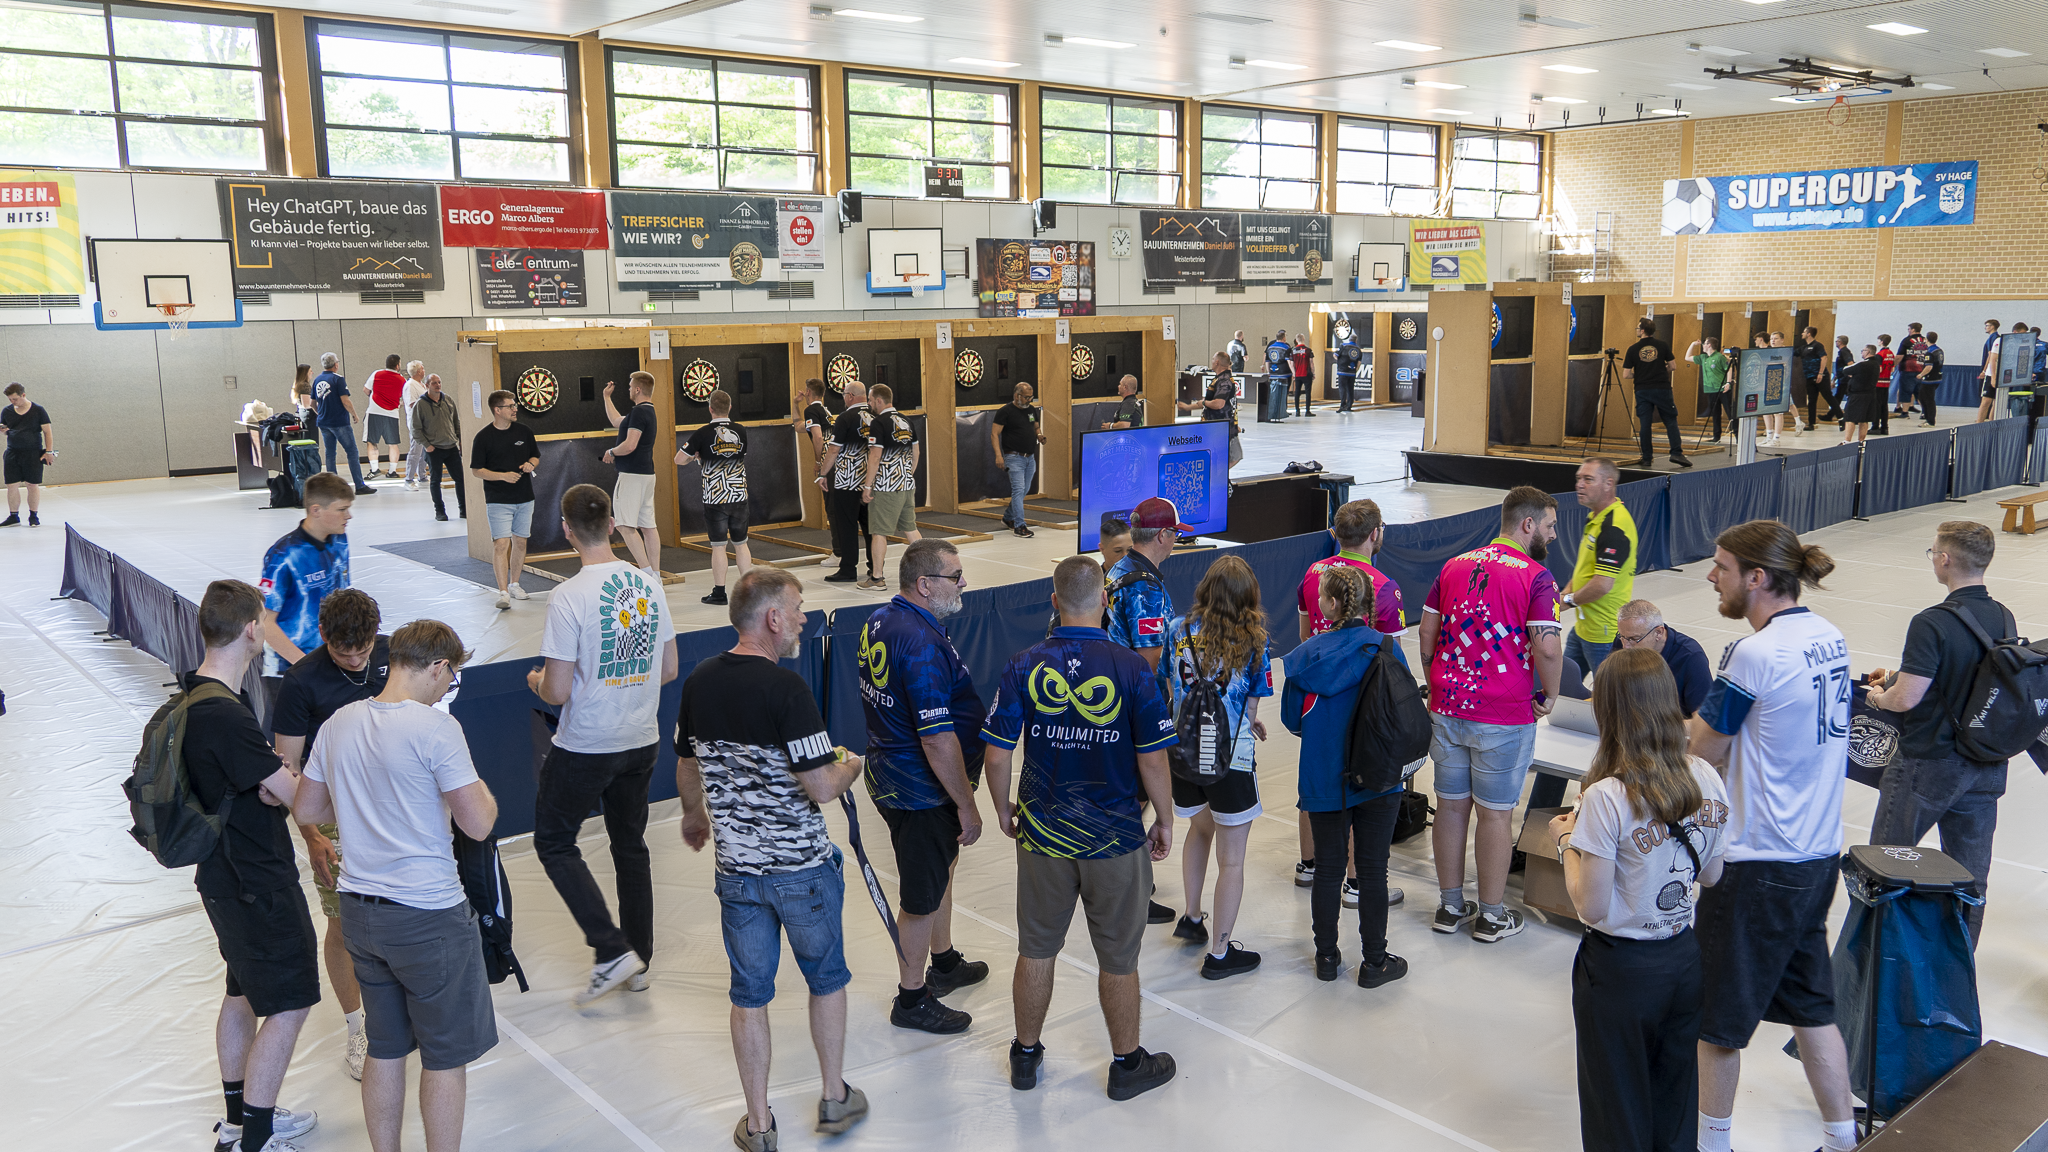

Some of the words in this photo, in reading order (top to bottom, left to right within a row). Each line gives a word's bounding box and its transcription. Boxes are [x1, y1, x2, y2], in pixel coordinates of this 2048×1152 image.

[928, 178, 941, 186] HEIM
[1935, 173, 1947, 182] SV
[1948, 171, 1973, 181] HAGE
[1, 187, 55, 203] EBEN.
[1728, 170, 1899, 210] SUPERCUP
[247, 197, 280, 217] Hey
[283, 198, 357, 216] ChatGPT,
[360, 199, 399, 215] baue
[402, 200, 428, 215] das
[500, 203, 564, 214] Generalagentur
[740, 208, 751, 217] TB
[7, 211, 50, 223] HITS!
[448, 209, 494, 225] ERGO
[501, 214, 527, 222] Marco
[528, 214, 554, 223] Albers
[622, 215, 704, 228] TREFFSICHER
[796, 218, 807, 226] Wir
[249, 218, 324, 234] Gebäude
[327, 219, 375, 237] fertig.
[501, 225, 553, 233] marco-albers.ergo.de
[792, 226, 812, 235] stellen
[622, 232, 649, 244] WIE
[651, 233, 682, 244] WIR?
[1415, 231, 1427, 240] WIR
[1428, 230, 1448, 239] LIEBEN
[1449, 229, 1459, 238] DAS
[1460, 228, 1480, 237] LEBEN.
[251, 240, 259, 248] KI
[261, 240, 282, 248] kann
[282, 240, 298, 248] viel
[307, 240, 340, 250] Projekte
[342, 240, 368, 249] bauen
[369, 240, 383, 249] wir
[383, 240, 406, 249] lieber
[407, 240, 430, 249] selbst.
[1143, 240, 1204, 250] BAUUNTERNEHMEN
[1204, 241, 1222, 250] Daniel
[1246, 244, 1288, 253] VOLLTREFFER
[343, 272, 403, 280] BAUUNTERNEHMEN
[1060, 328, 1065, 338] 4
[1166, 325, 1171, 335] 5
[807, 337, 814, 348] 2
[941, 332, 947, 343] 3
[1168, 434, 1203, 446] Webseite
[1115, 445, 1142, 456] MASTERS
[1499, 554, 1529, 569] SINS
[599, 573, 624, 664] BRINGING
[623, 571, 653, 598] THE
[1803, 639, 1848, 669] MÜLLE
[605, 678, 621, 686] TIME
[1812, 664, 1852, 746] 13
[1046, 725, 1120, 744] UNLIMITED
[787, 730, 834, 764] PUM
[1051, 741, 1091, 750] KRAICHTAL
[1199, 724, 1217, 775] PUMA
[1400, 756, 1428, 778] PUMA
[1641, 919, 1674, 930] ATHLETIC
